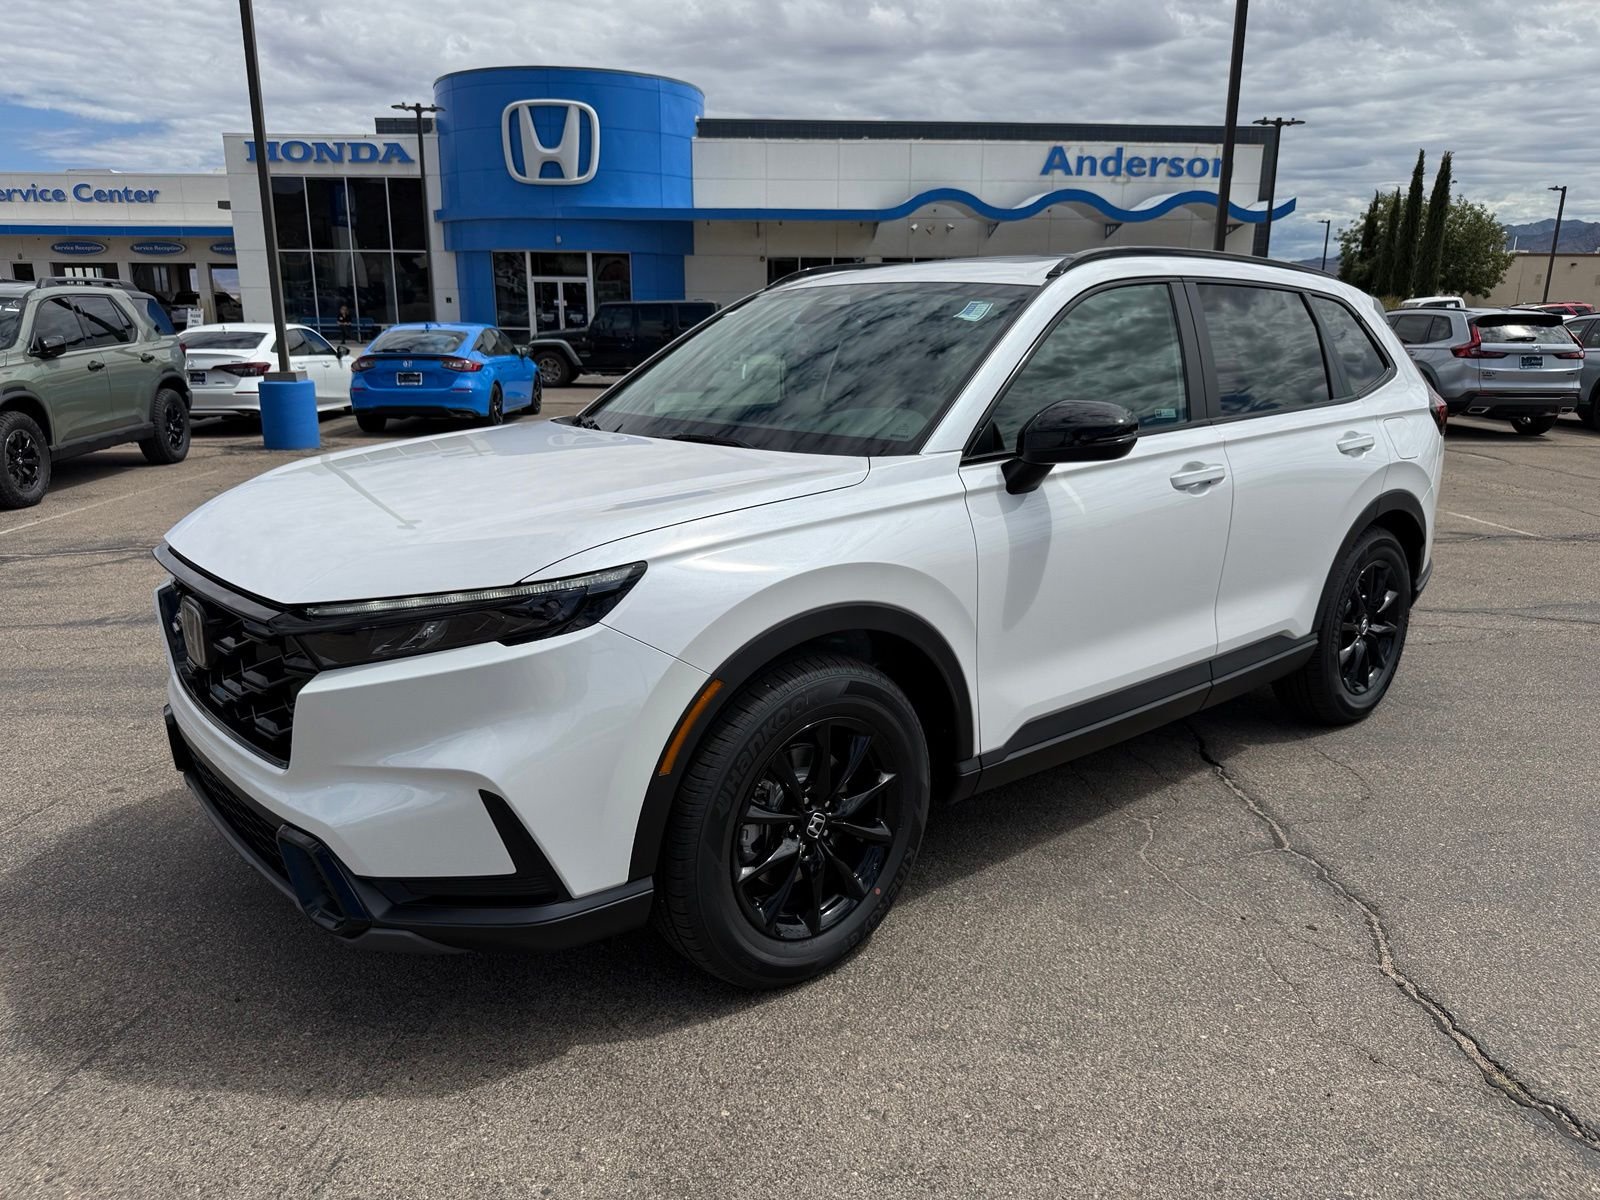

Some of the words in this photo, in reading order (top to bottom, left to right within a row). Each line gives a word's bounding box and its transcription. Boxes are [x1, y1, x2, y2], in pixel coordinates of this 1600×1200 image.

[244, 140, 415, 164] HONDA
[73, 183, 159, 203] Center
[54, 243, 74, 251] Service
[133, 243, 153, 251] Service
